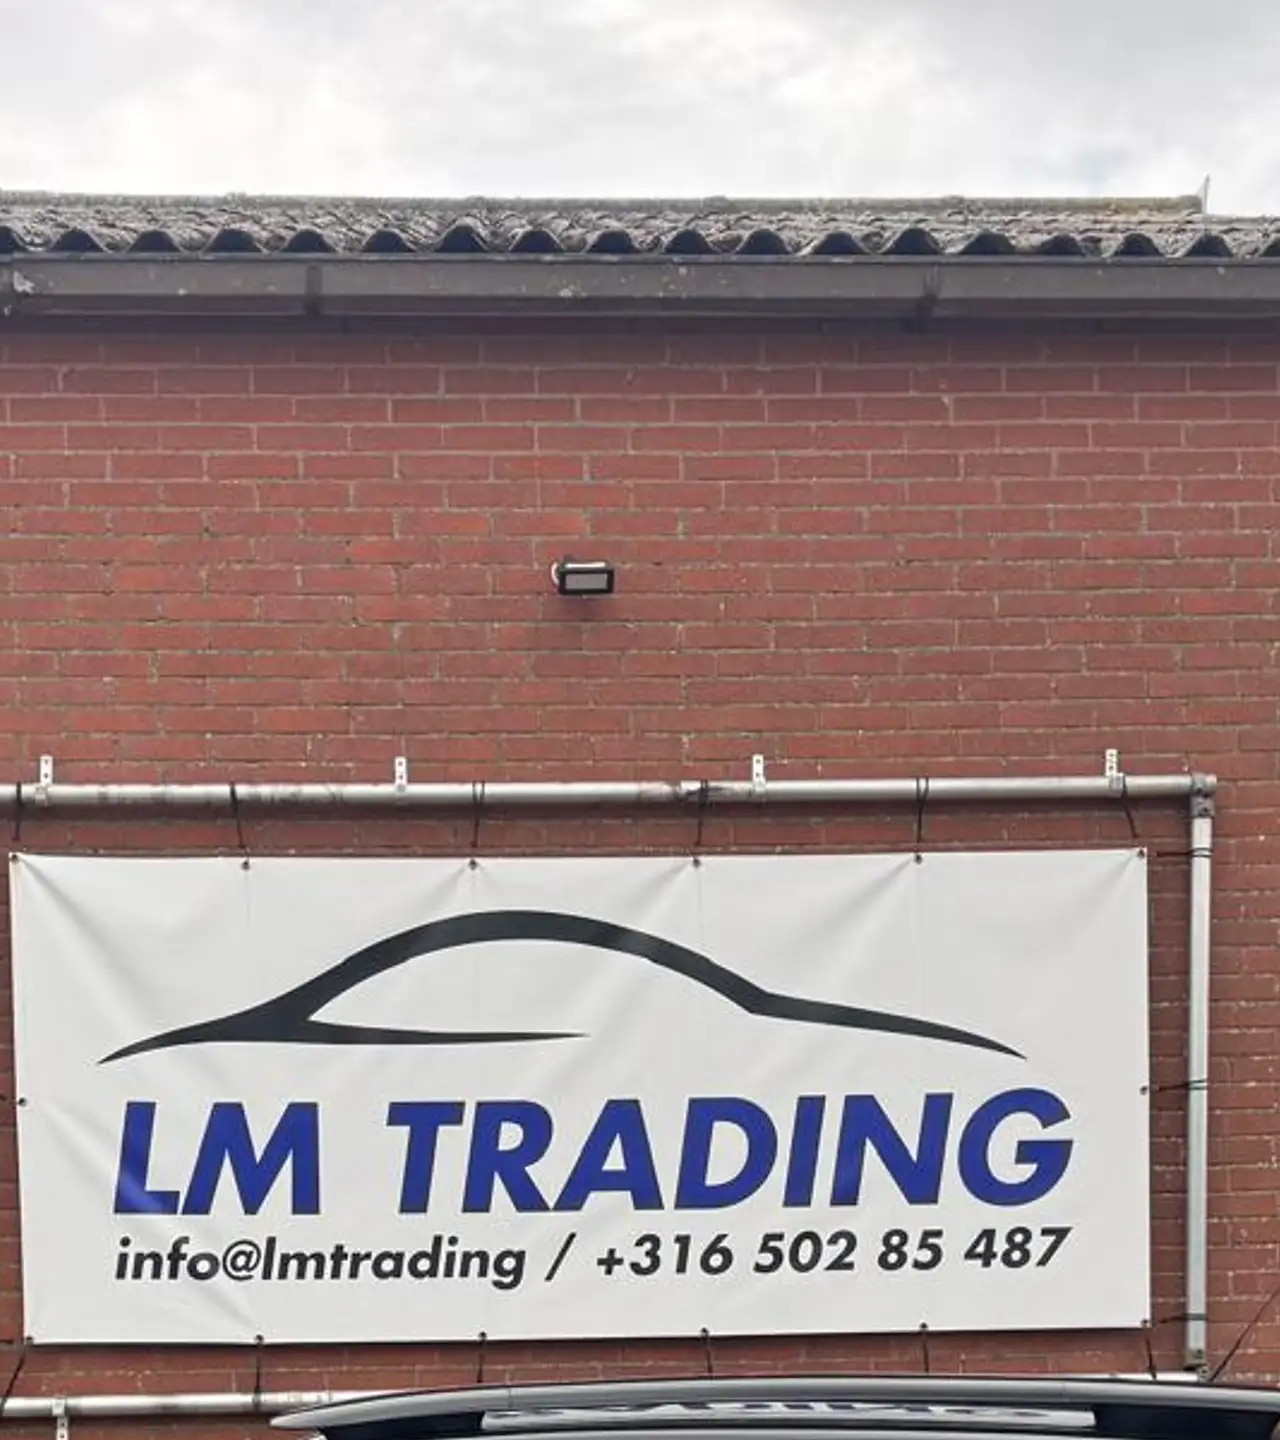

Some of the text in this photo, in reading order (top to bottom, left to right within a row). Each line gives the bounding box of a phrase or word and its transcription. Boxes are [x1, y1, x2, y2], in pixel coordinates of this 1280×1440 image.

[113, 1087, 1074, 1216] LM TRADING
[115, 1226, 1072, 1291] info@lmtrading / +316 502 85 487
